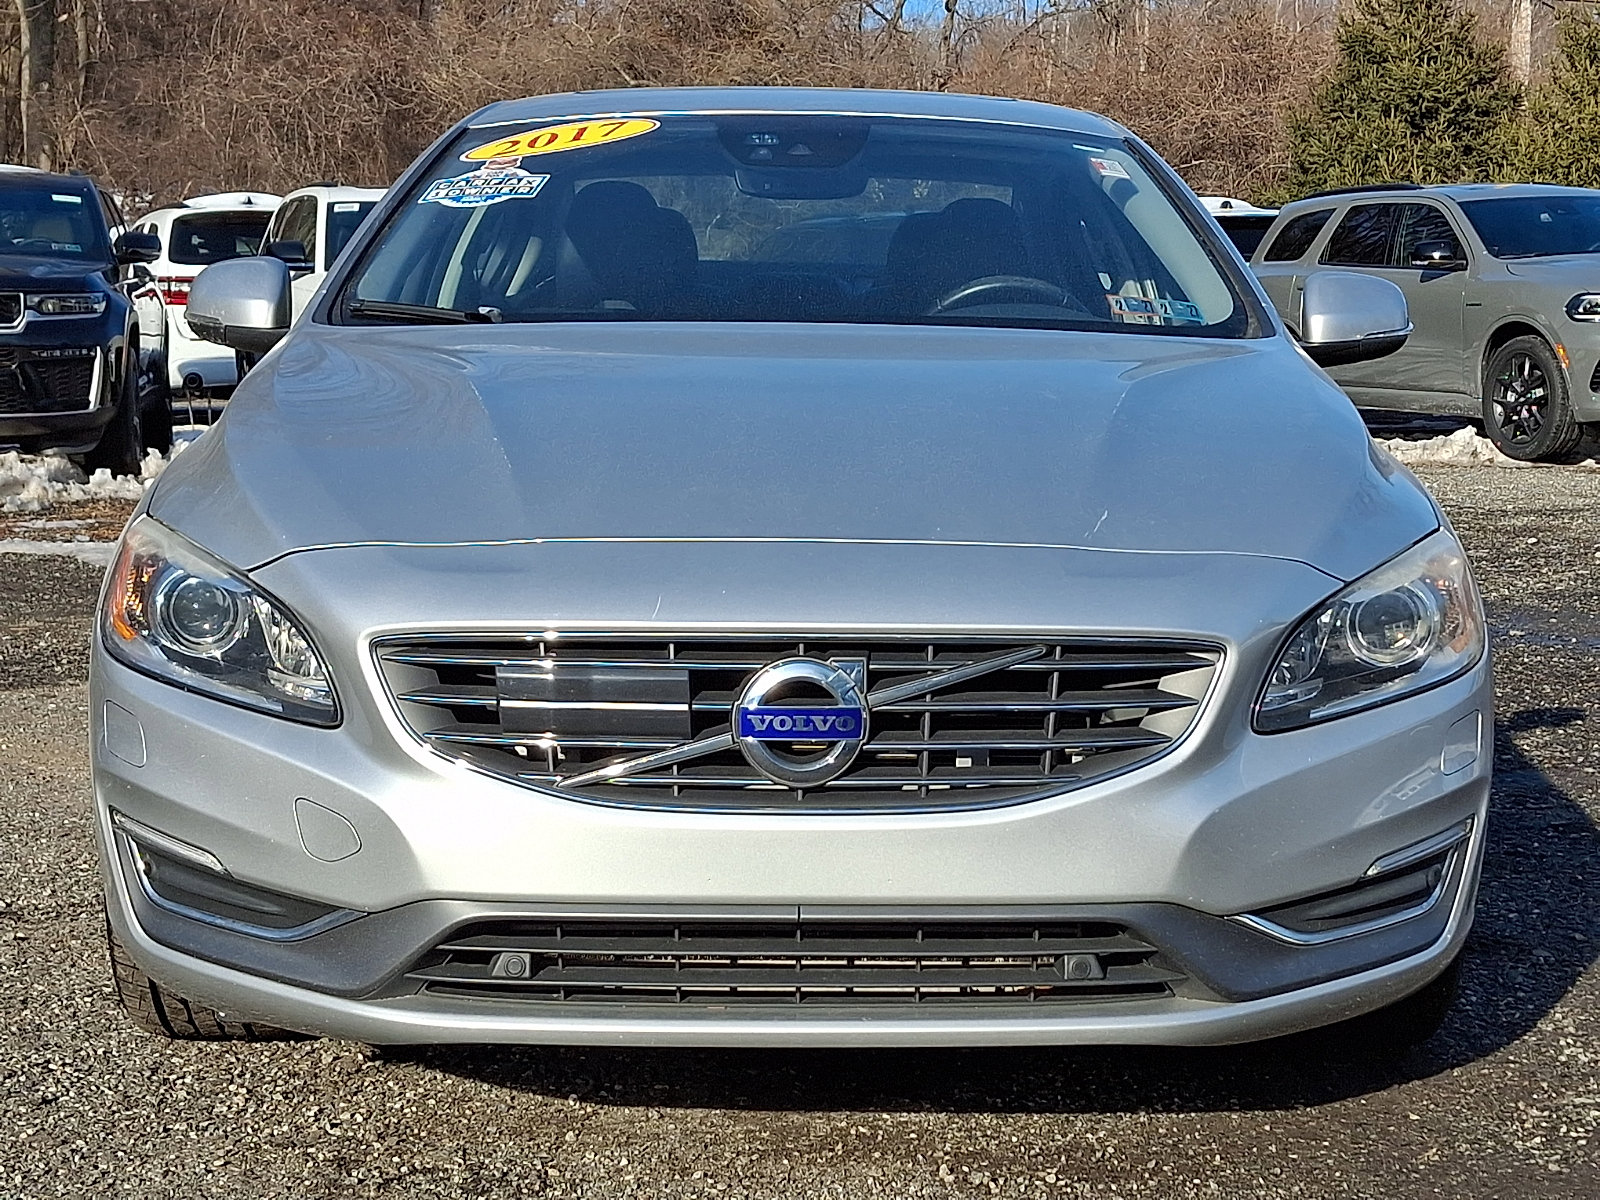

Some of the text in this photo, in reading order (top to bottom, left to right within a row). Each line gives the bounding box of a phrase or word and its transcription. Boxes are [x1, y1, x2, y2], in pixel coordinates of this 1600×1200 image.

[491, 121, 629, 157] 2017
[437, 177, 538, 189] CARFAX
[747, 715, 855, 731] VOLVO
